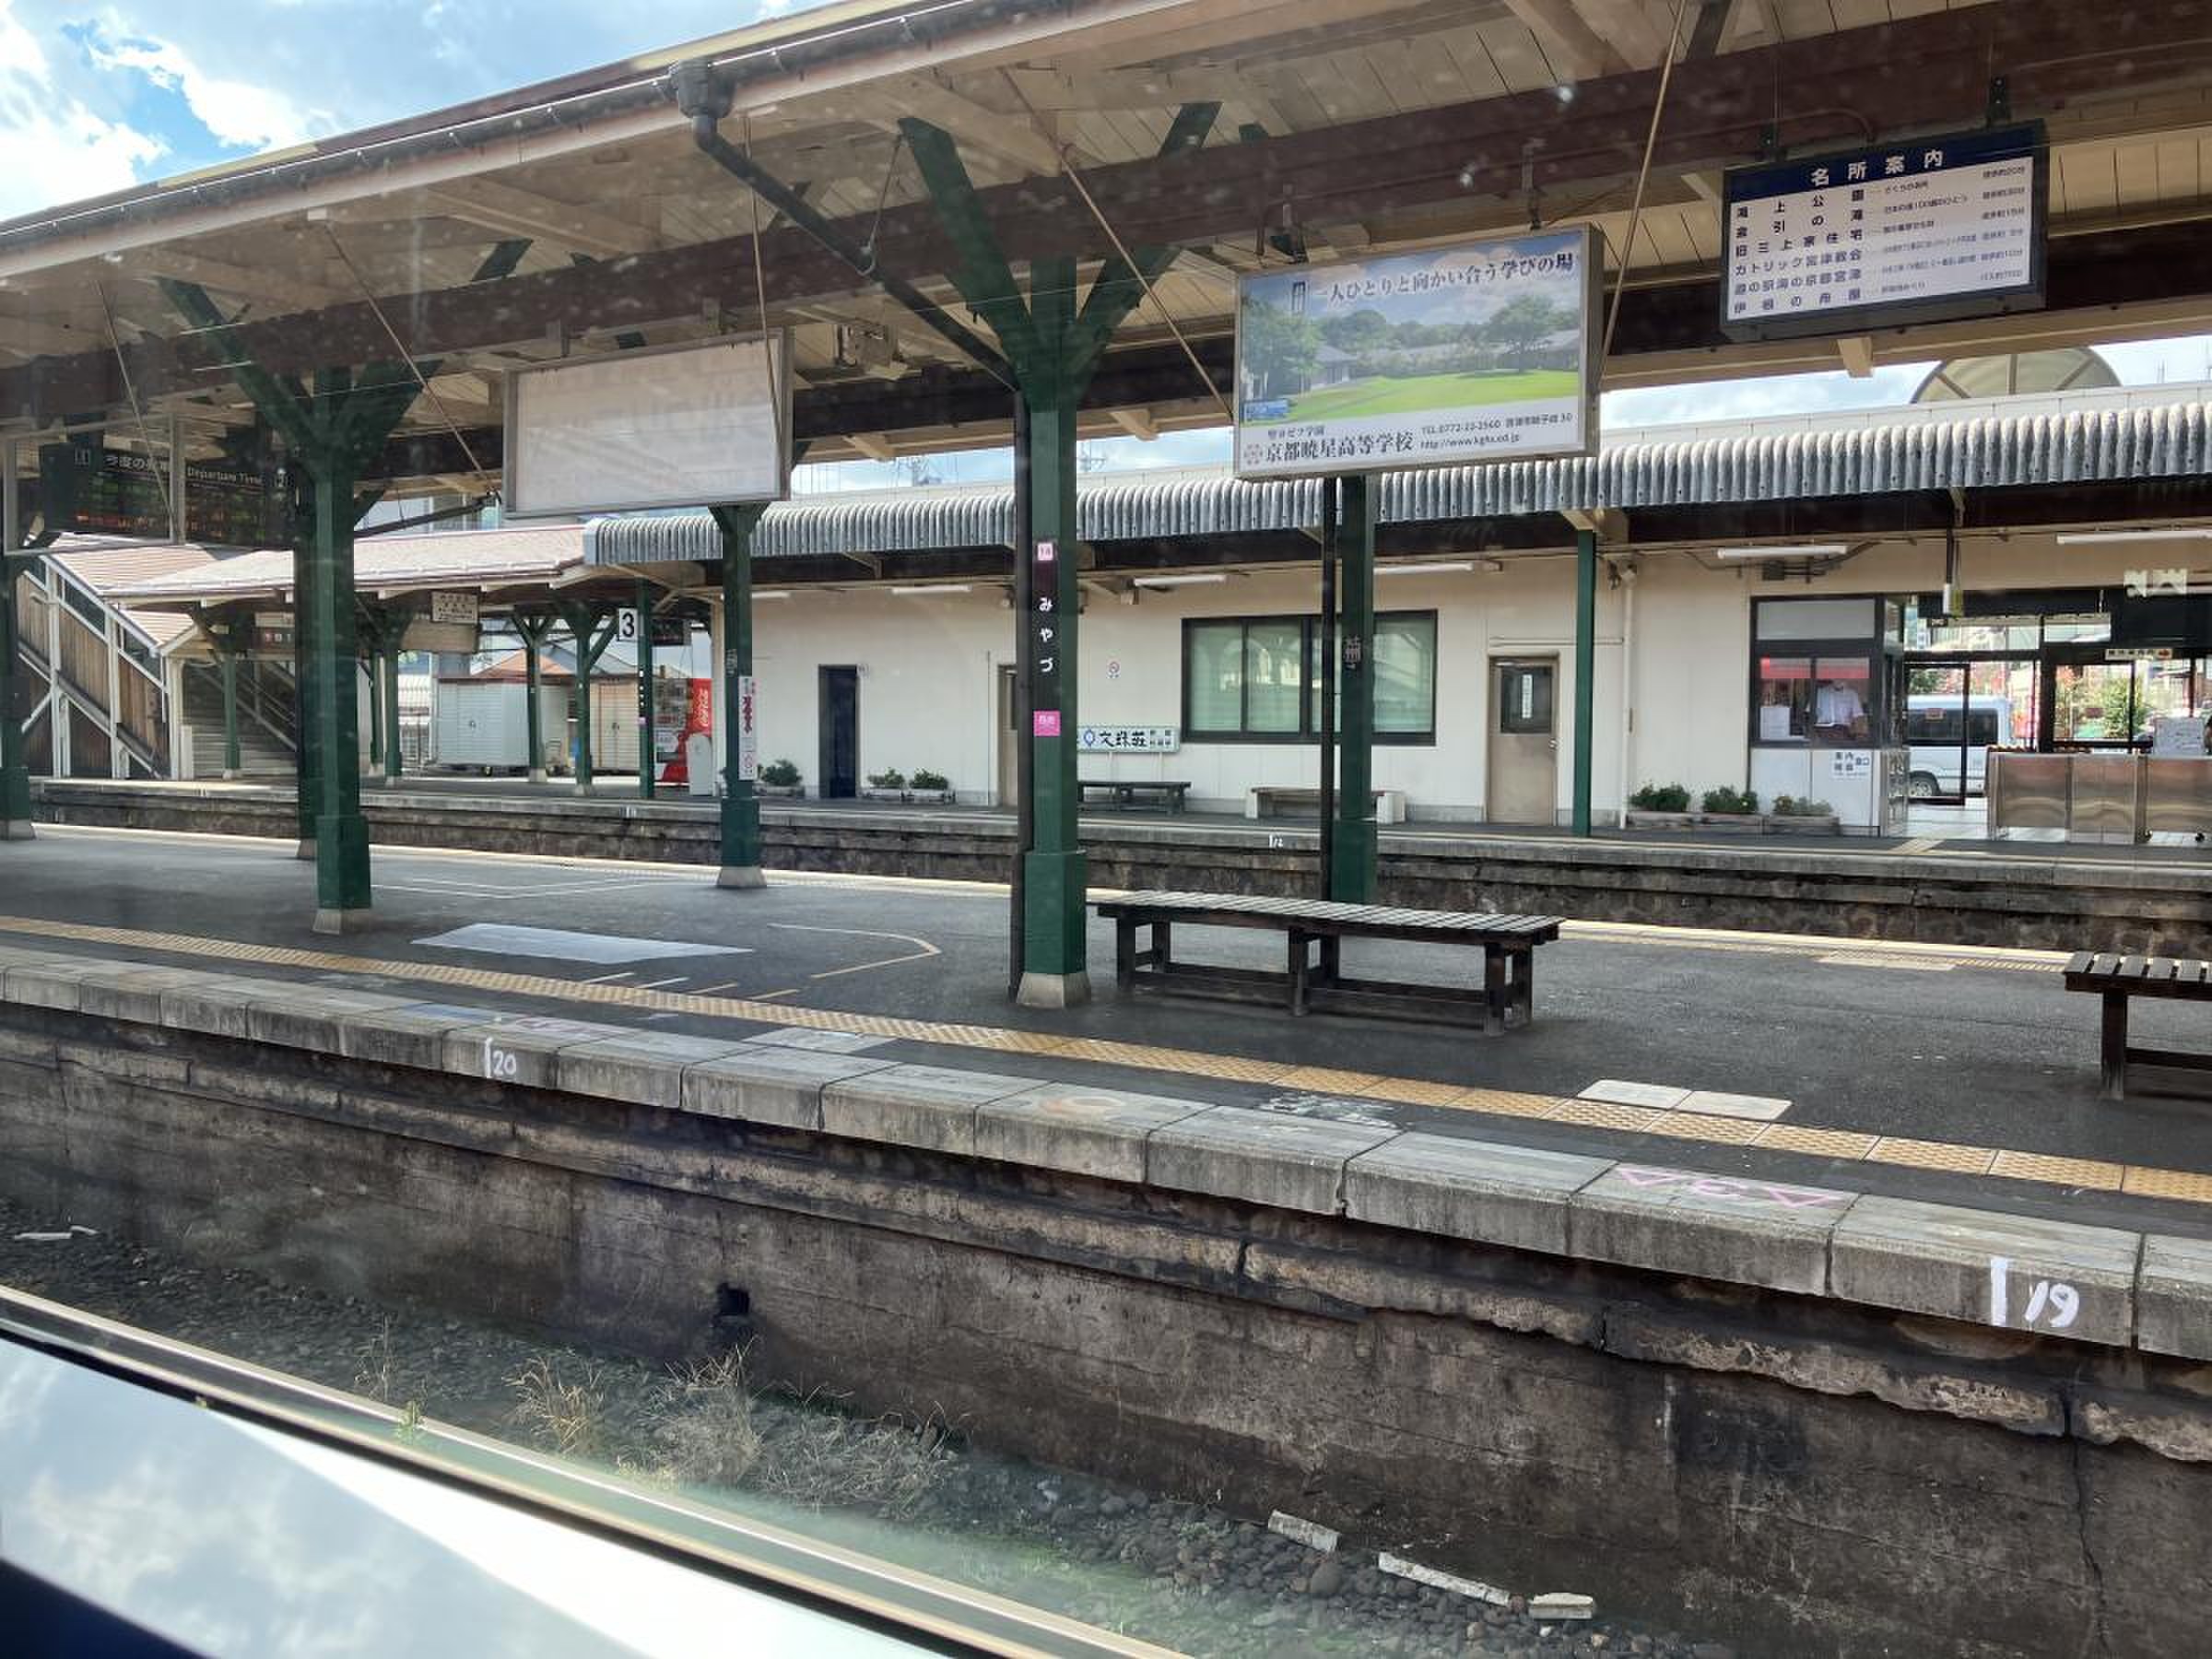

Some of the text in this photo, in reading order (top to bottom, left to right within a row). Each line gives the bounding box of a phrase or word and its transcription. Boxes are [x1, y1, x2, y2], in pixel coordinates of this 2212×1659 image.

[1810, 149, 1944, 186] 名所案内
[1735, 229, 1863, 257] 旧三上家住宅
[1315, 253, 1573, 301] 一人ひとりと向かい合う学びの場
[1266, 431, 1413, 462] 京都暁星高等学校
[622, 612, 635, 638] 3
[1039, 597, 1053, 673] みやづ
